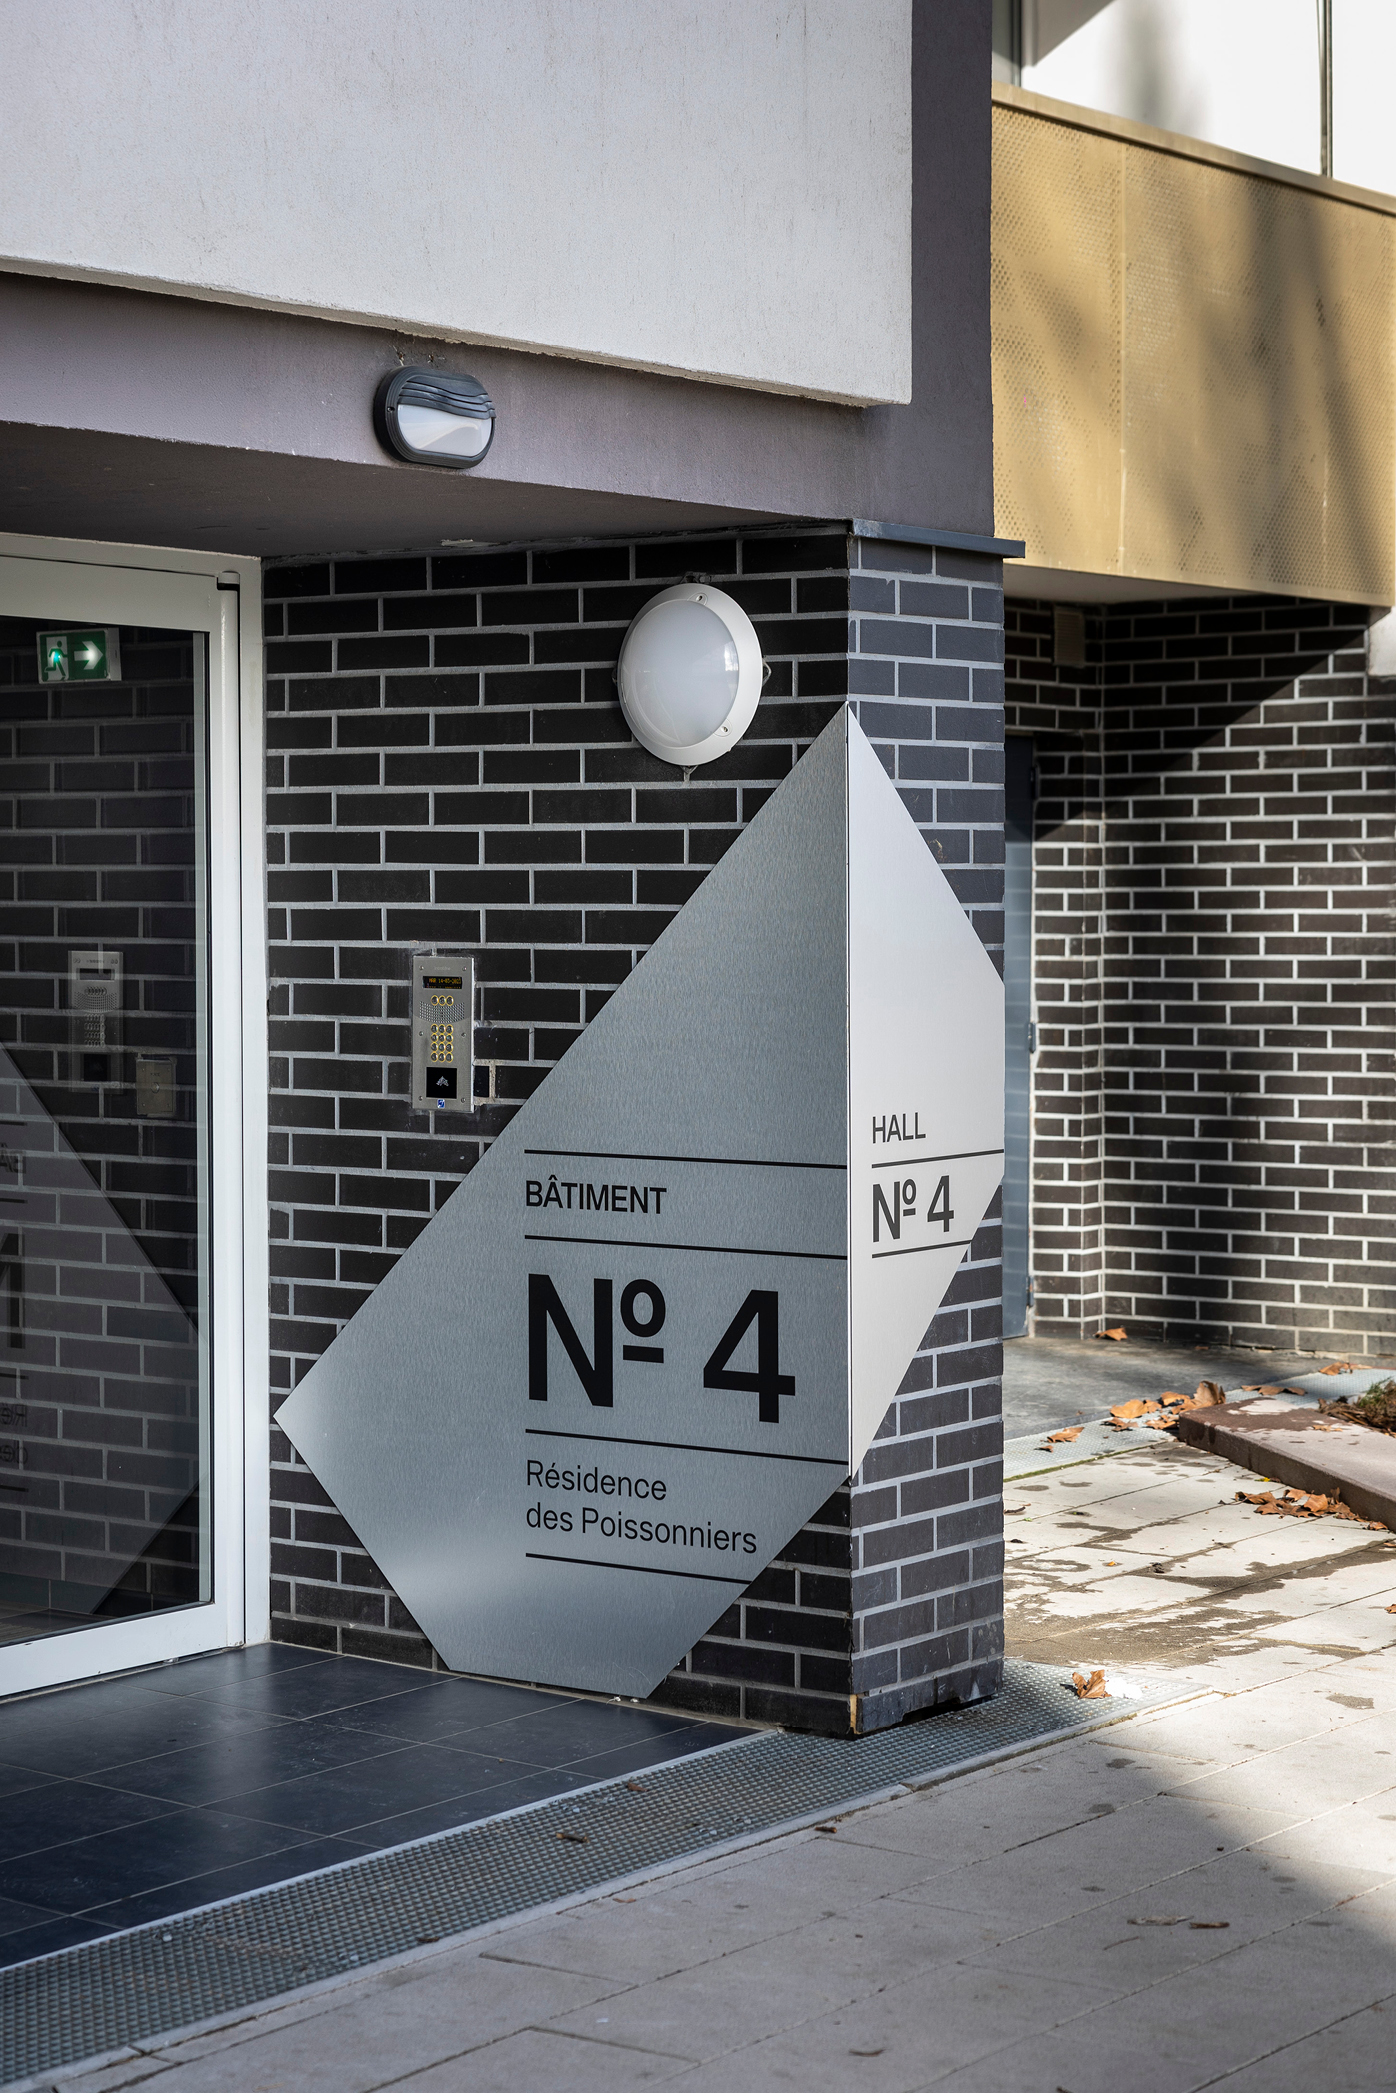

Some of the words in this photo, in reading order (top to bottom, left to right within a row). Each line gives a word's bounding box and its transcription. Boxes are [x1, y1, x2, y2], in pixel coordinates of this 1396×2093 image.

[872, 1112, 926, 1144] HALL
[525, 1174, 668, 1215] BÂTIMENT
[927, 1174, 955, 1233] 4
[703, 1289, 796, 1424] 4
[526, 1459, 667, 1501] Résidence
[526, 1501, 573, 1532] des
[582, 1506, 757, 1554] Poissonniers
